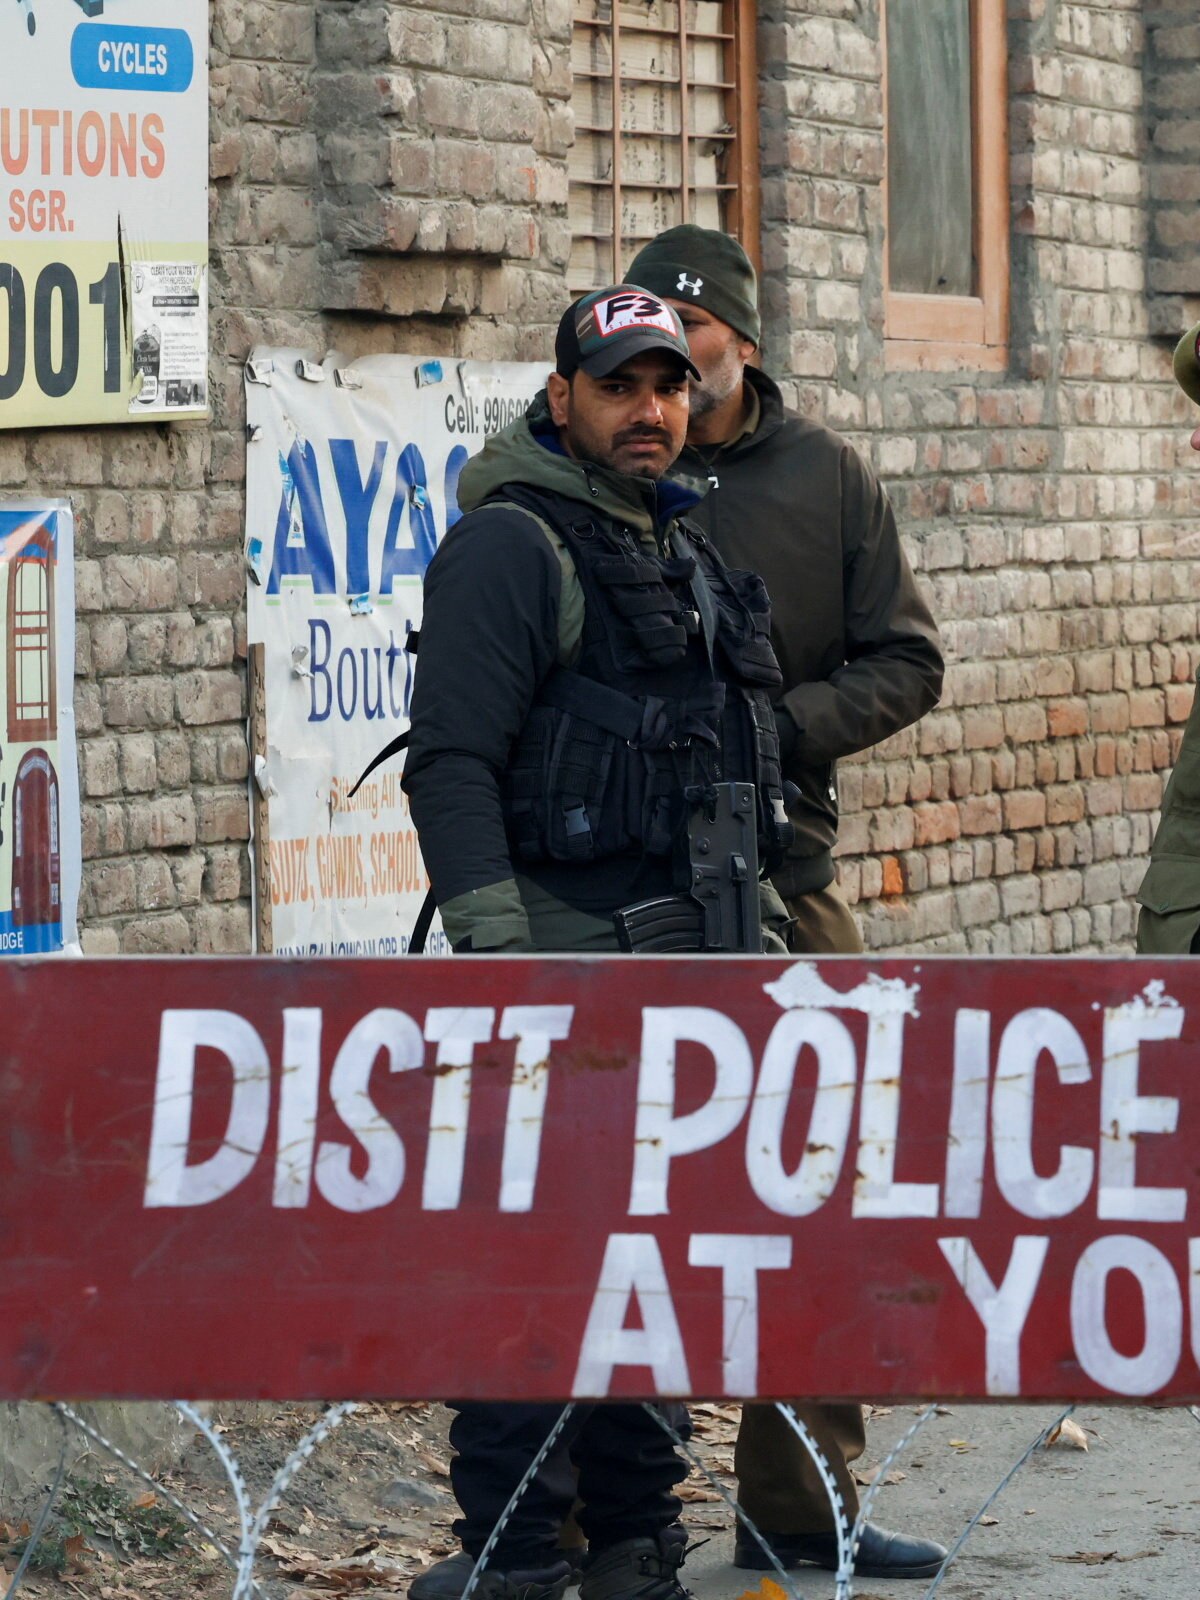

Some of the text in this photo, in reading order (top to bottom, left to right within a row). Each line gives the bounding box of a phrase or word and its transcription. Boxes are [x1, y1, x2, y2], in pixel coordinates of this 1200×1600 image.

[97, 40, 168, 76] CYCLES
[0, 107, 166, 179] UTIONS
[8, 188, 75, 233] SGR.
[444, 394, 479, 434] Cell:
[380, 772, 395, 809] All
[370, 829, 420, 898] SCHOOL
[143, 1004, 576, 1213] DISTT
[626, 1004, 1189, 1222] POLICE
[571, 1232, 793, 1399] AT
